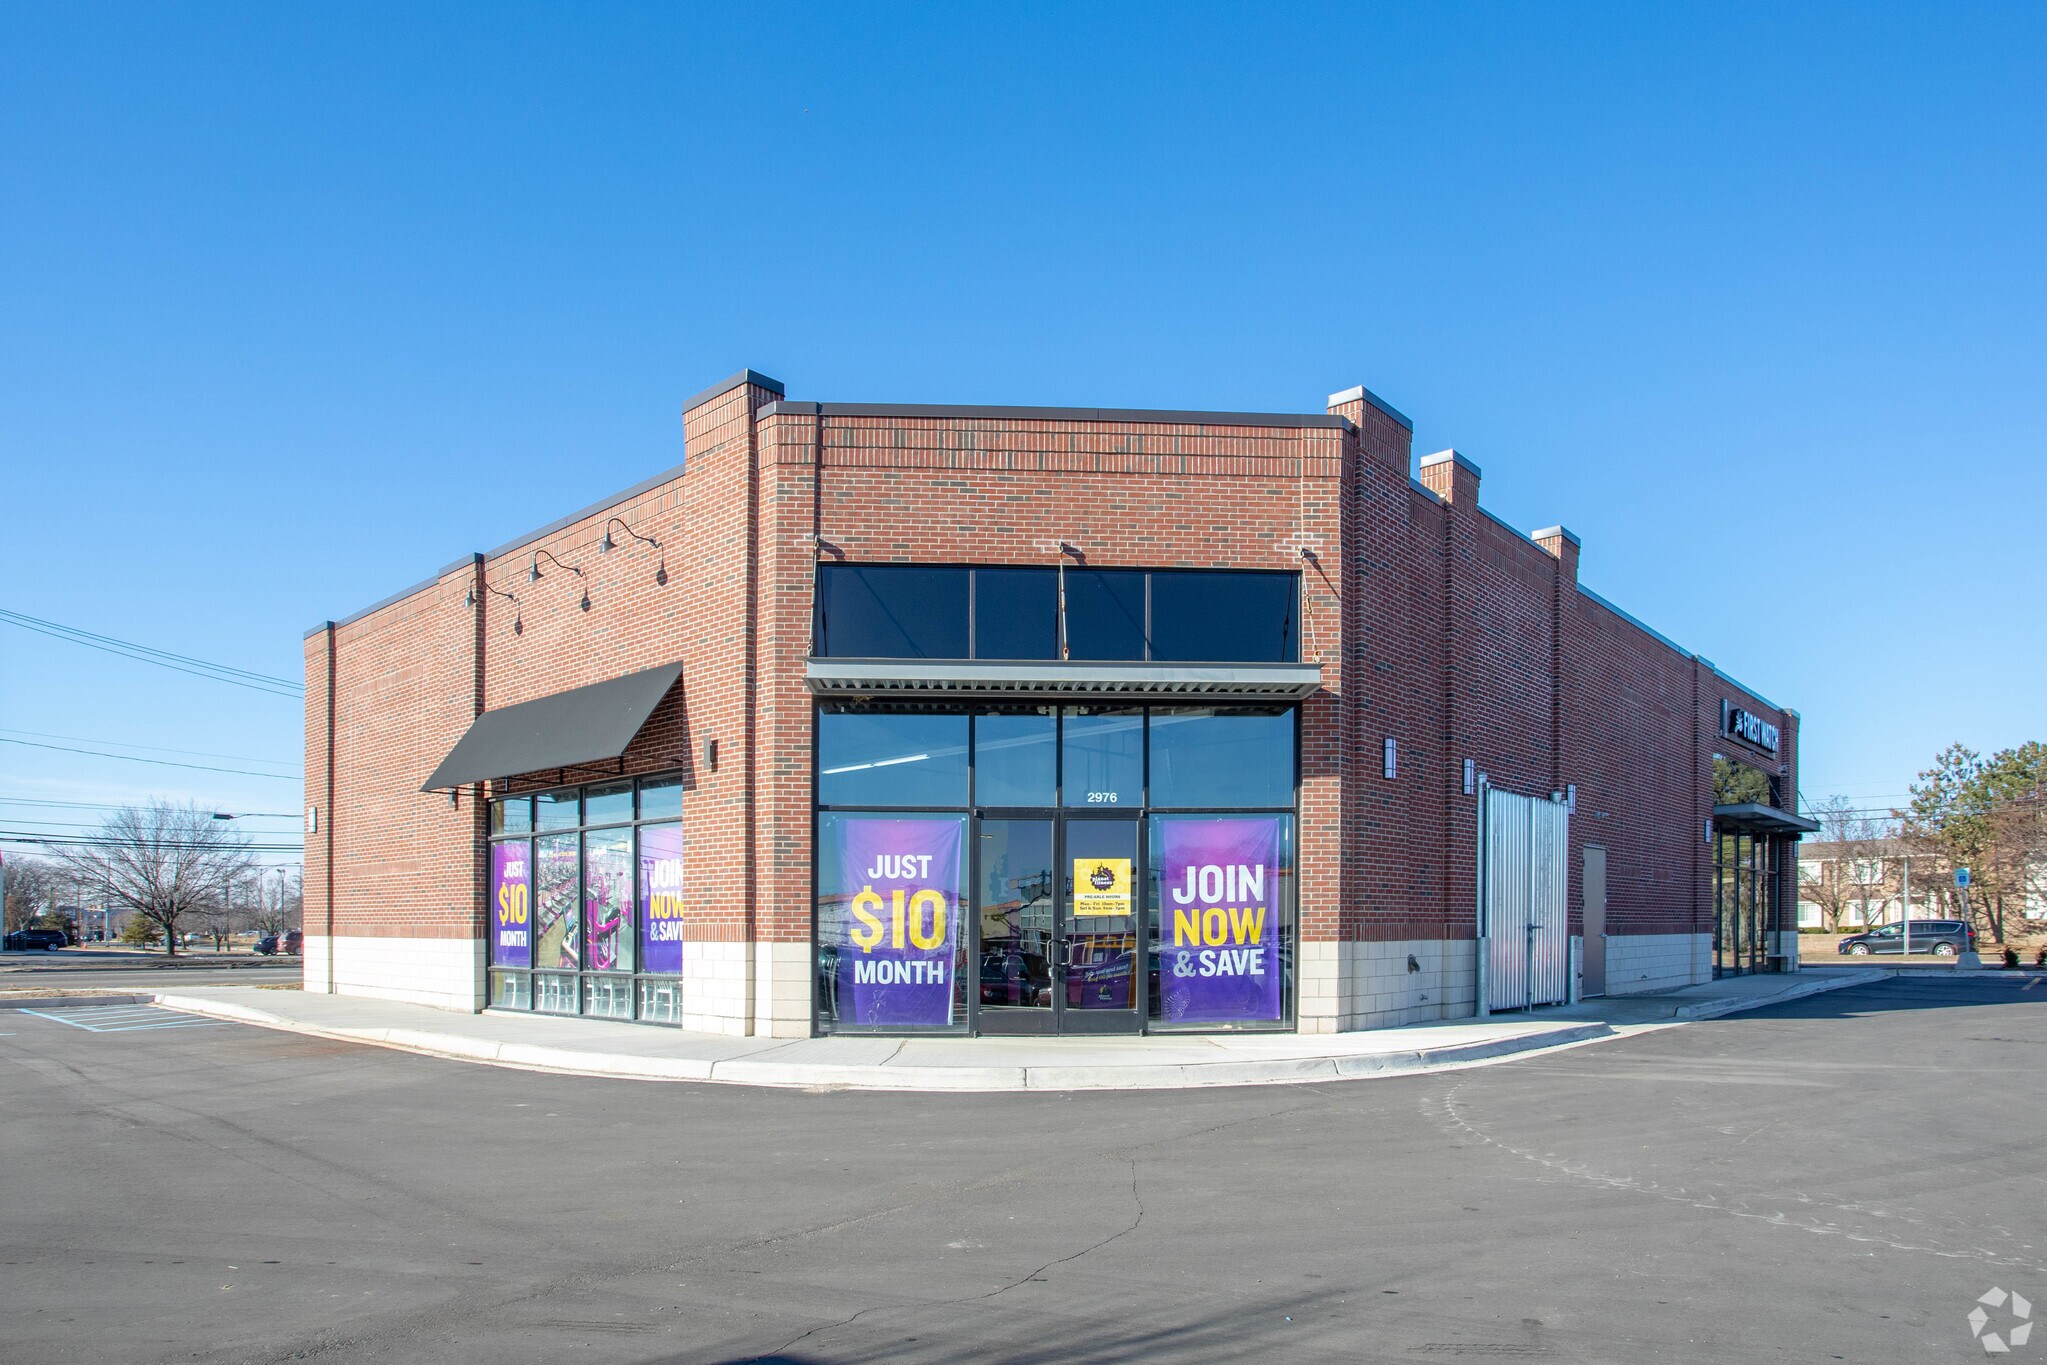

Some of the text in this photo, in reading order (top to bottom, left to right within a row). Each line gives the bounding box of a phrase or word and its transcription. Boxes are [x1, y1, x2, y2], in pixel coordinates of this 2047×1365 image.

[1744, 711, 1778, 752] FIRST WATCH
[1087, 792, 1118, 803] 2976
[504, 861, 524, 877] JUST
[867, 855, 932, 879] JUST
[1172, 864, 1264, 904] JOIN
[498, 882, 528, 926] $10
[649, 890, 683, 919] NOW
[650, 922, 659, 942] &
[851, 885, 946, 954] $10
[1174, 907, 1266, 947] NOW
[500, 930, 527, 946] MONTH
[855, 960, 944, 984] MONTH
[1173, 949, 1264, 978] & SAVE
